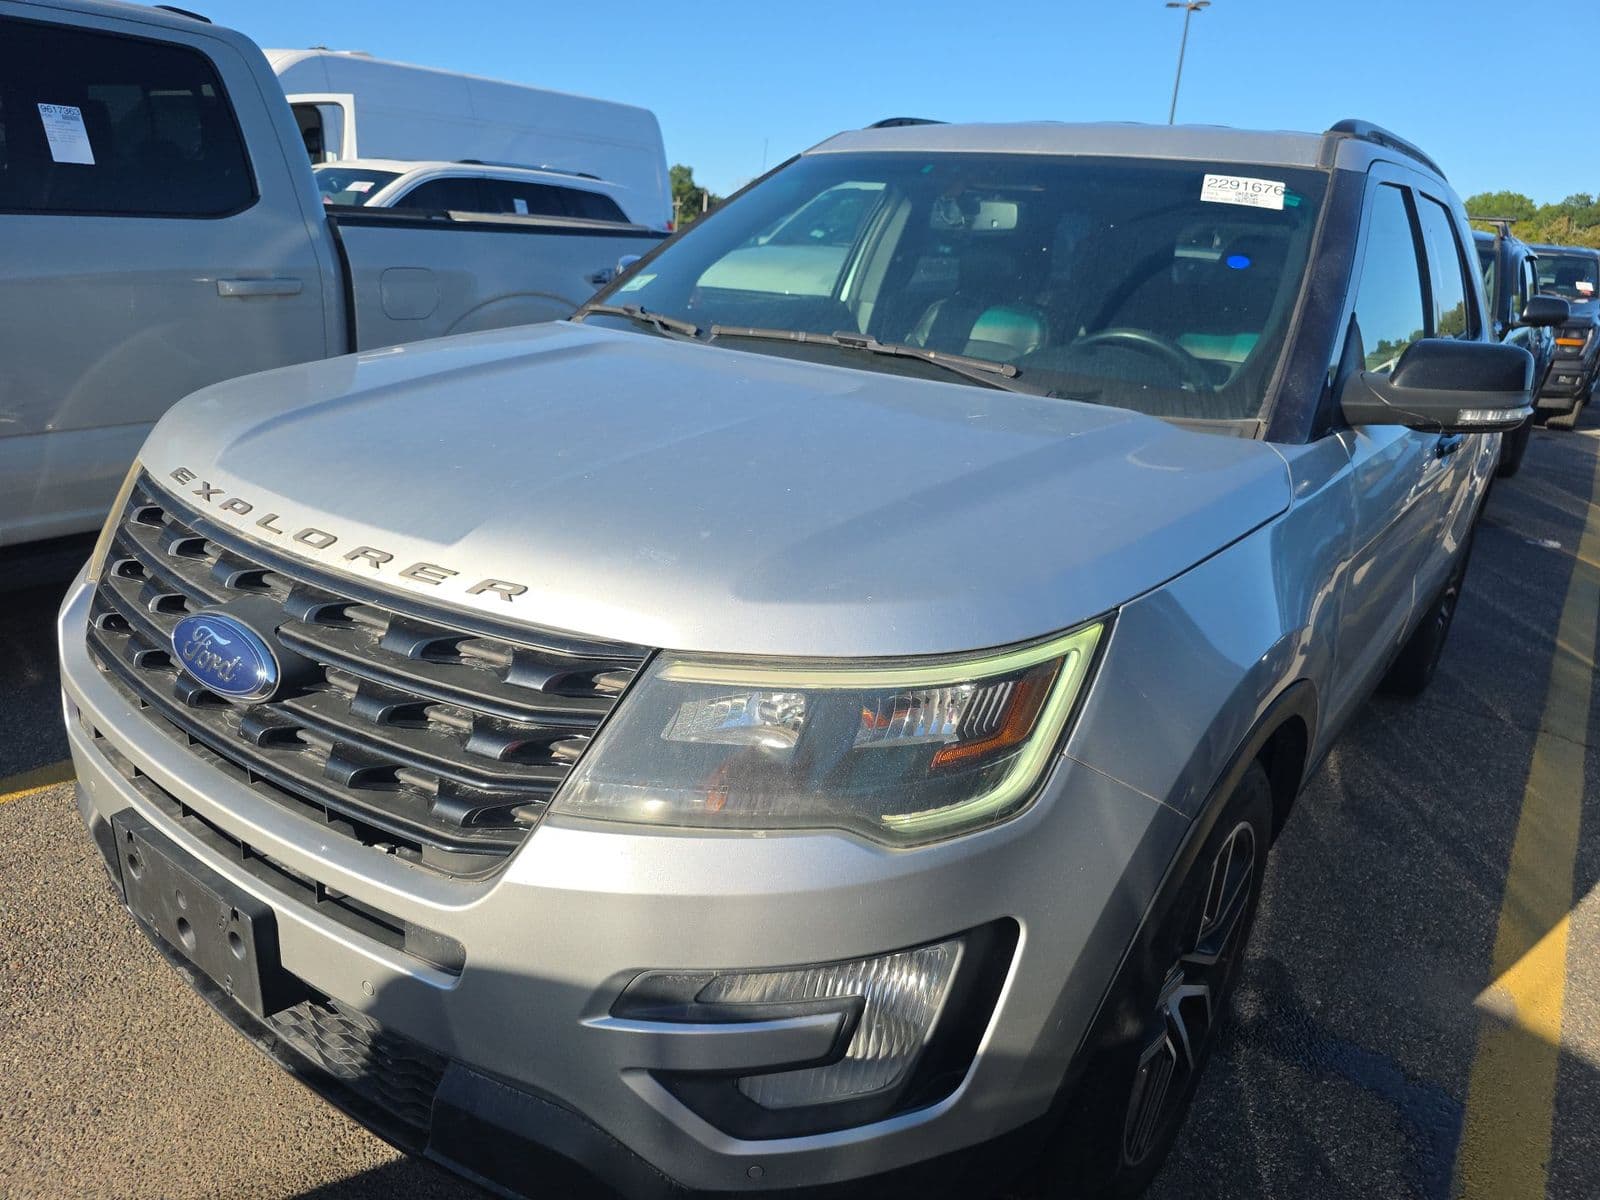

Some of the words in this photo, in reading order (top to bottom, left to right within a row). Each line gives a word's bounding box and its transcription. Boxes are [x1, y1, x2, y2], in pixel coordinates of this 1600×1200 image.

[1207, 178, 1285, 196] 2291676
[169, 466, 529, 602] EXPLORER
[182, 625, 242, 682] Ford
